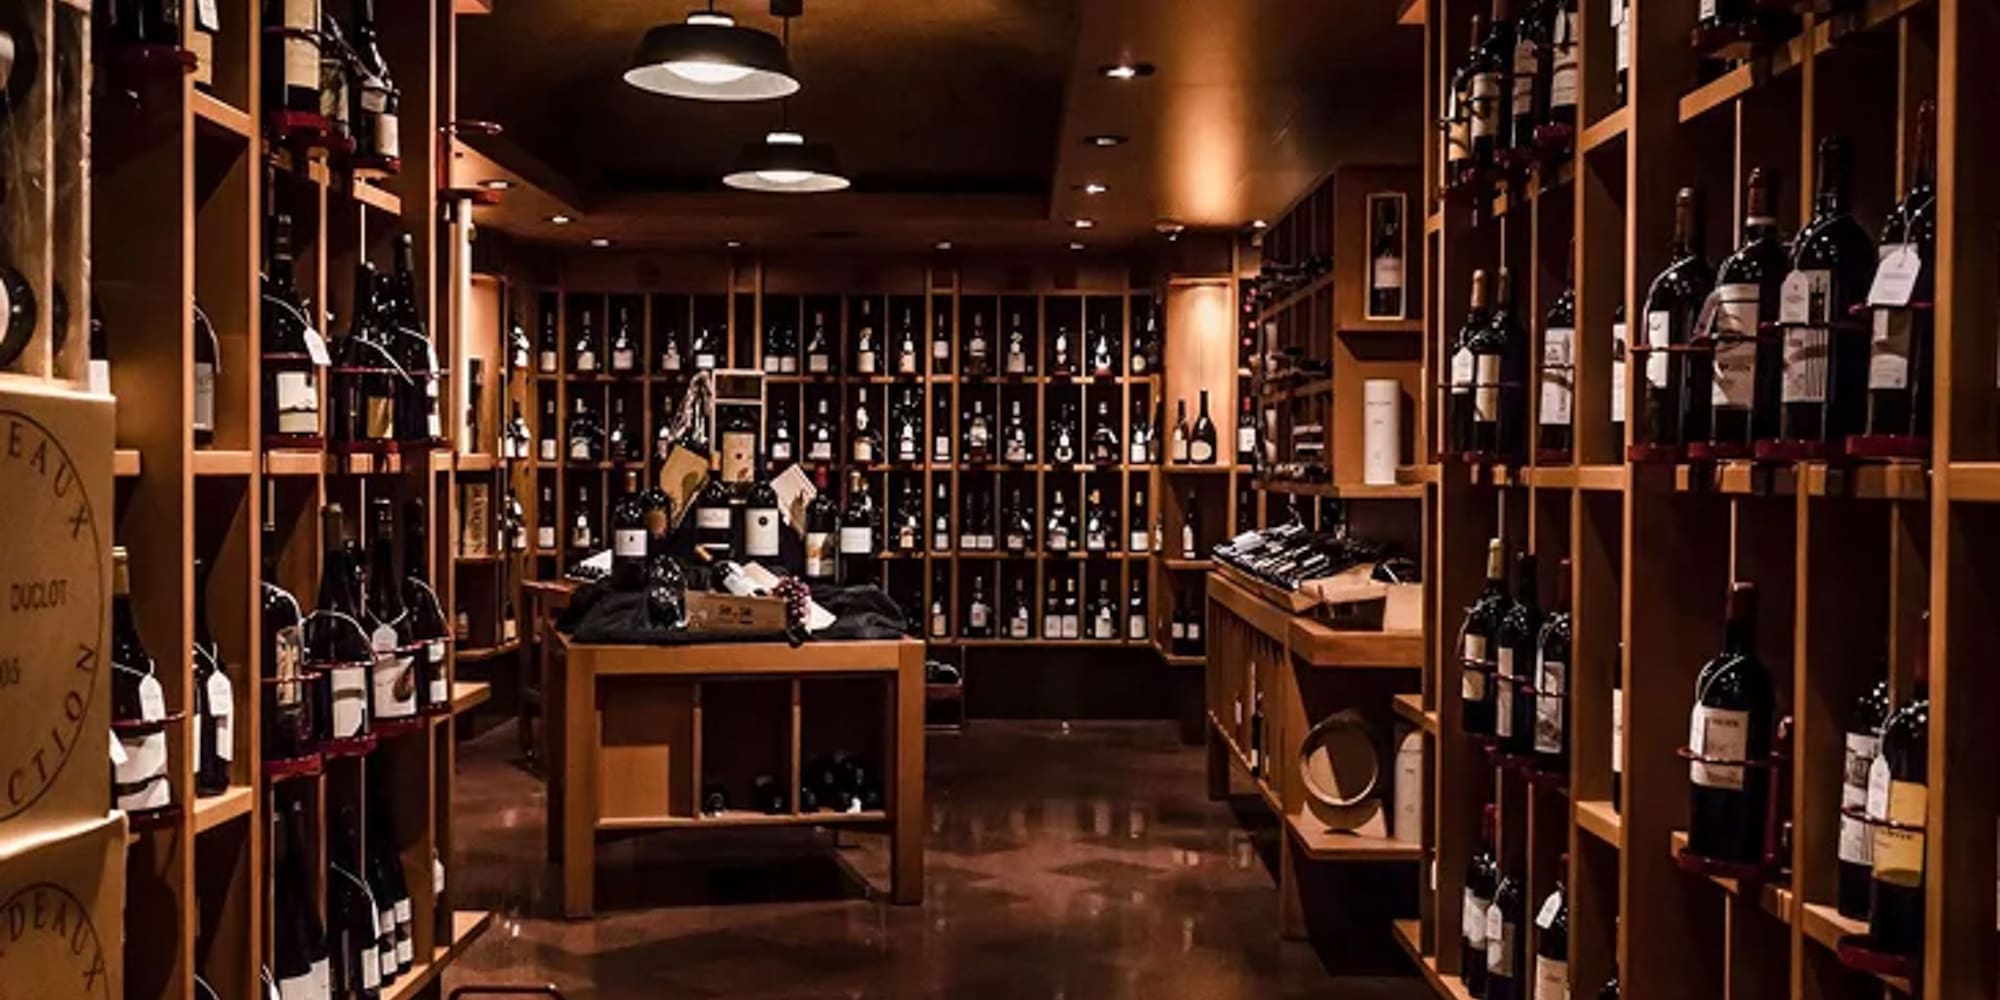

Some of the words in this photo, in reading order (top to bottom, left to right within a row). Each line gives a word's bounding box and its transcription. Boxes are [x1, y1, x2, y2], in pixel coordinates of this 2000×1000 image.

[8, 421, 88, 539] EAUX
[10, 579, 68, 613] DUCLOT
[7, 644, 95, 806] CTION
[0, 890, 104, 992] DEAUX
